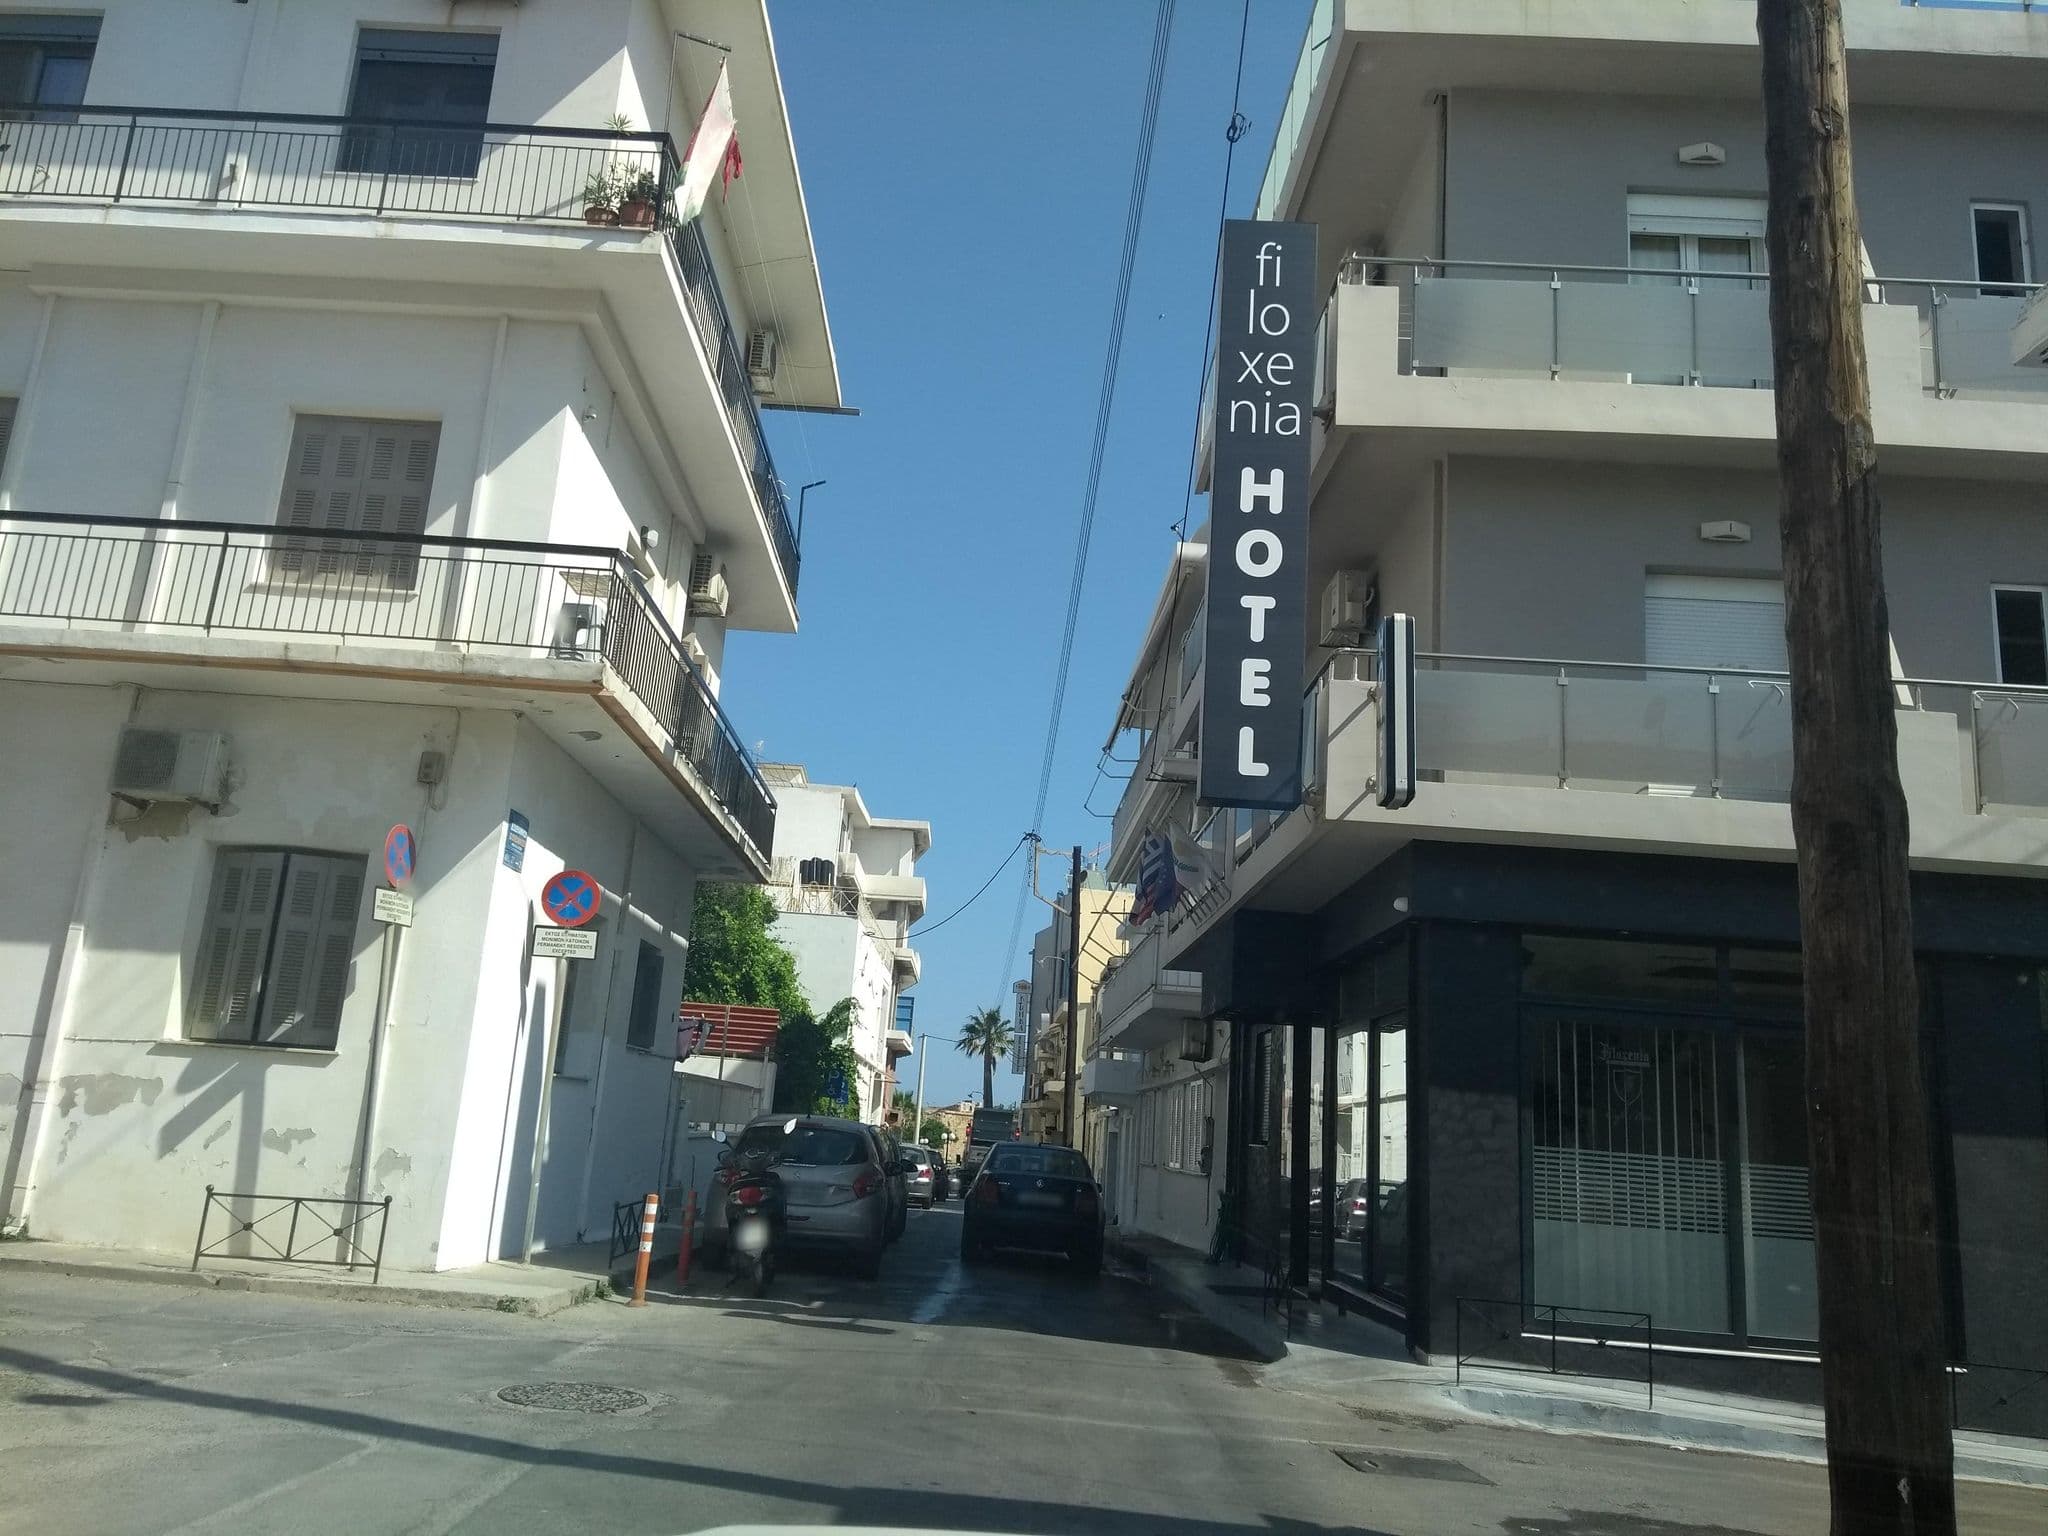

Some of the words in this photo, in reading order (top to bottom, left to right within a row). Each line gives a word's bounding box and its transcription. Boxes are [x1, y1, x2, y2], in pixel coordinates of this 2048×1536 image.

[1255, 241, 1283, 287] fi
[1248, 288, 1290, 336] lo
[1236, 351, 1294, 386] xe
[1230, 390, 1301, 436] nia
[1235, 466, 1284, 777] HOTEL
